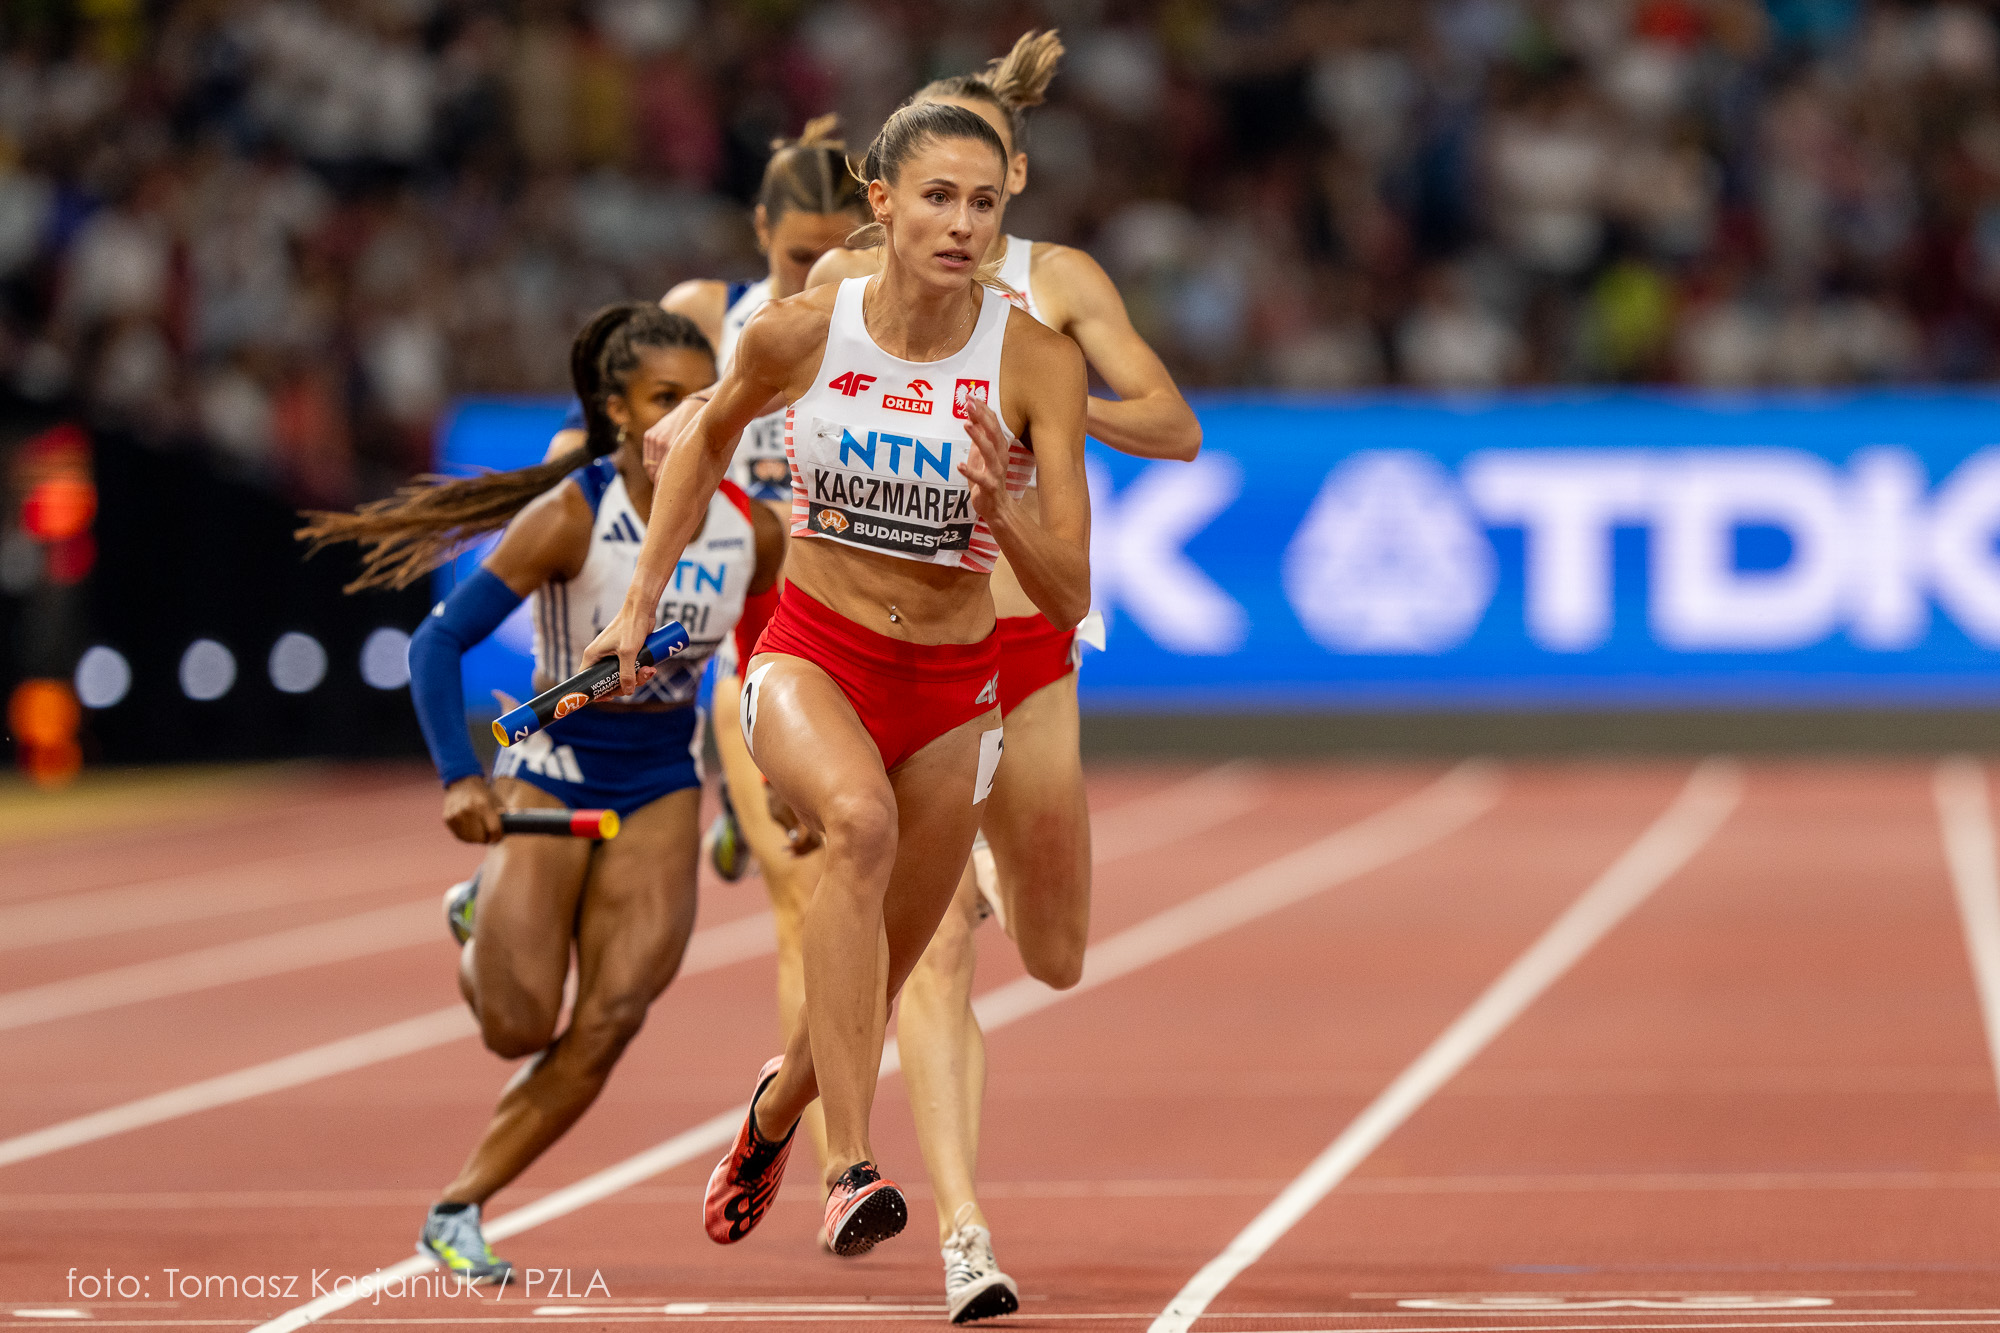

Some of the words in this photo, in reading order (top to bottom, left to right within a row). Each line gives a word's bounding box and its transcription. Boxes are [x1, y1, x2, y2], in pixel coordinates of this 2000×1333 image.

[828, 371, 877, 397] 4F
[885, 397, 930, 413] ORLEN
[839, 428, 952, 482] NTN
[814, 468, 971, 523] KACZMAREK
[853, 520, 944, 547] BUDAPEST
[658, 601, 710, 634] ERI
[590, 676, 611, 691] WORLD
